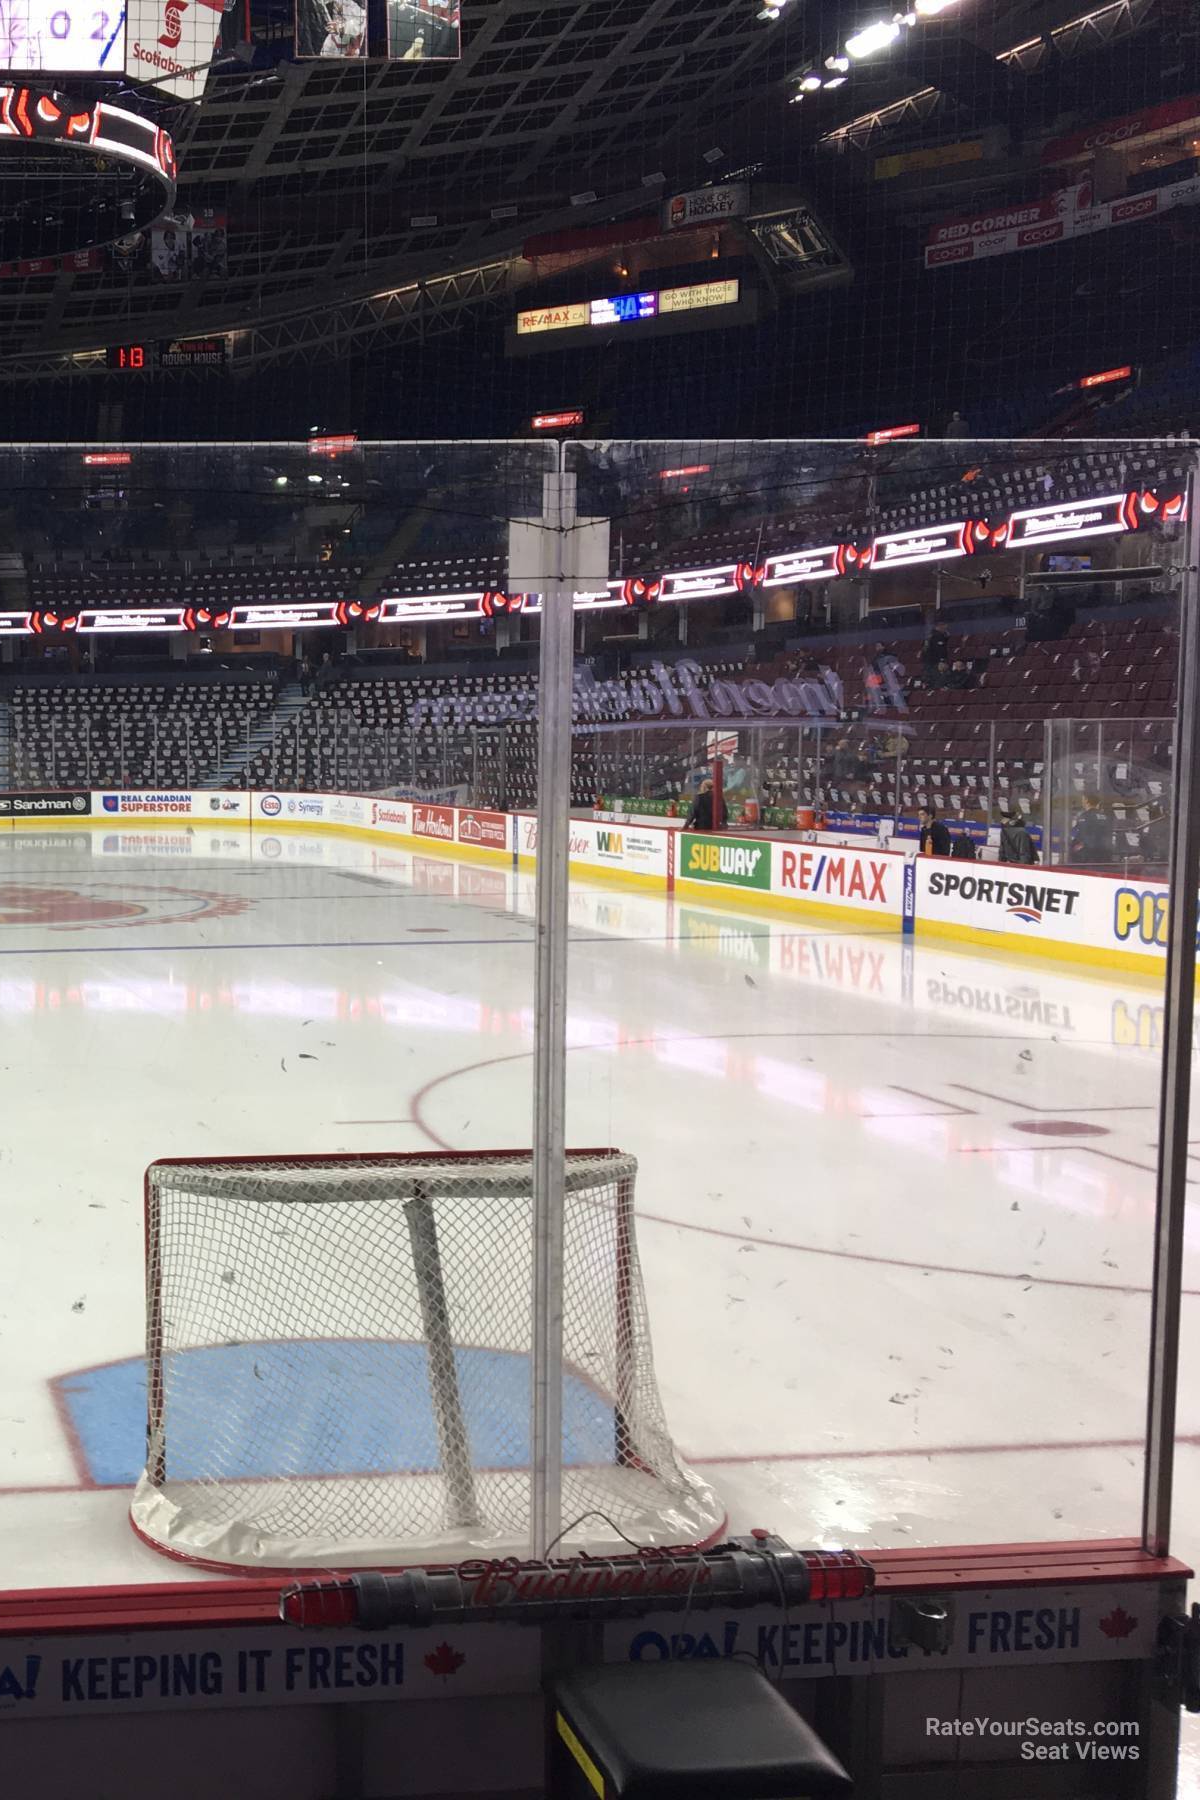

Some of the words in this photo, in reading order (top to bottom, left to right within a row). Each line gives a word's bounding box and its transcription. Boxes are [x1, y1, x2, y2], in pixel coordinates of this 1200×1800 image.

[1084, 121, 1142, 149] CO-OP
[689, 199, 734, 216] HOCKEY
[1116, 200, 1153, 217] CO-OP
[938, 223, 971, 242] RED
[971, 207, 1041, 235] CORNER
[978, 236, 1007, 248] CO-OP
[1023, 227, 1058, 242] CO-OP
[933, 245, 969, 262] CO-OP
[664, 291, 678, 301] GO
[679, 288, 703, 299] WITH
[704, 283, 734, 295] THOSE
[672, 296, 693, 308] WHO
[694, 293, 725, 305] KNOW
[522, 310, 570, 328] RE/MAX
[162, 353, 192, 366] ROUGH
[193, 351, 223, 364] HOUSE
[13, 799, 72, 811] Sandman
[121, 794, 139, 804] REAL
[141, 794, 192, 803] CANADIAN
[264, 801, 279, 809] Esso
[121, 803, 192, 813] SUPERSTORE
[298, 801, 323, 815] Synergy
[426, 808, 453, 838] Hortons
[596, 831, 624, 854] WM
[688, 844, 762, 878] SUBWAY
[781, 849, 888, 904] RE/MAX
[928, 871, 1080, 916] SPORTSNET
[460, 1552, 712, 1606] Budweiser
[630, 1620, 739, 1662] OPA!
[967, 1607, 1081, 1654] FRESH
[62, 1651, 222, 1702] KEEPING
[237, 1650, 272, 1693] IT
[285, 1643, 405, 1690] FRESH
